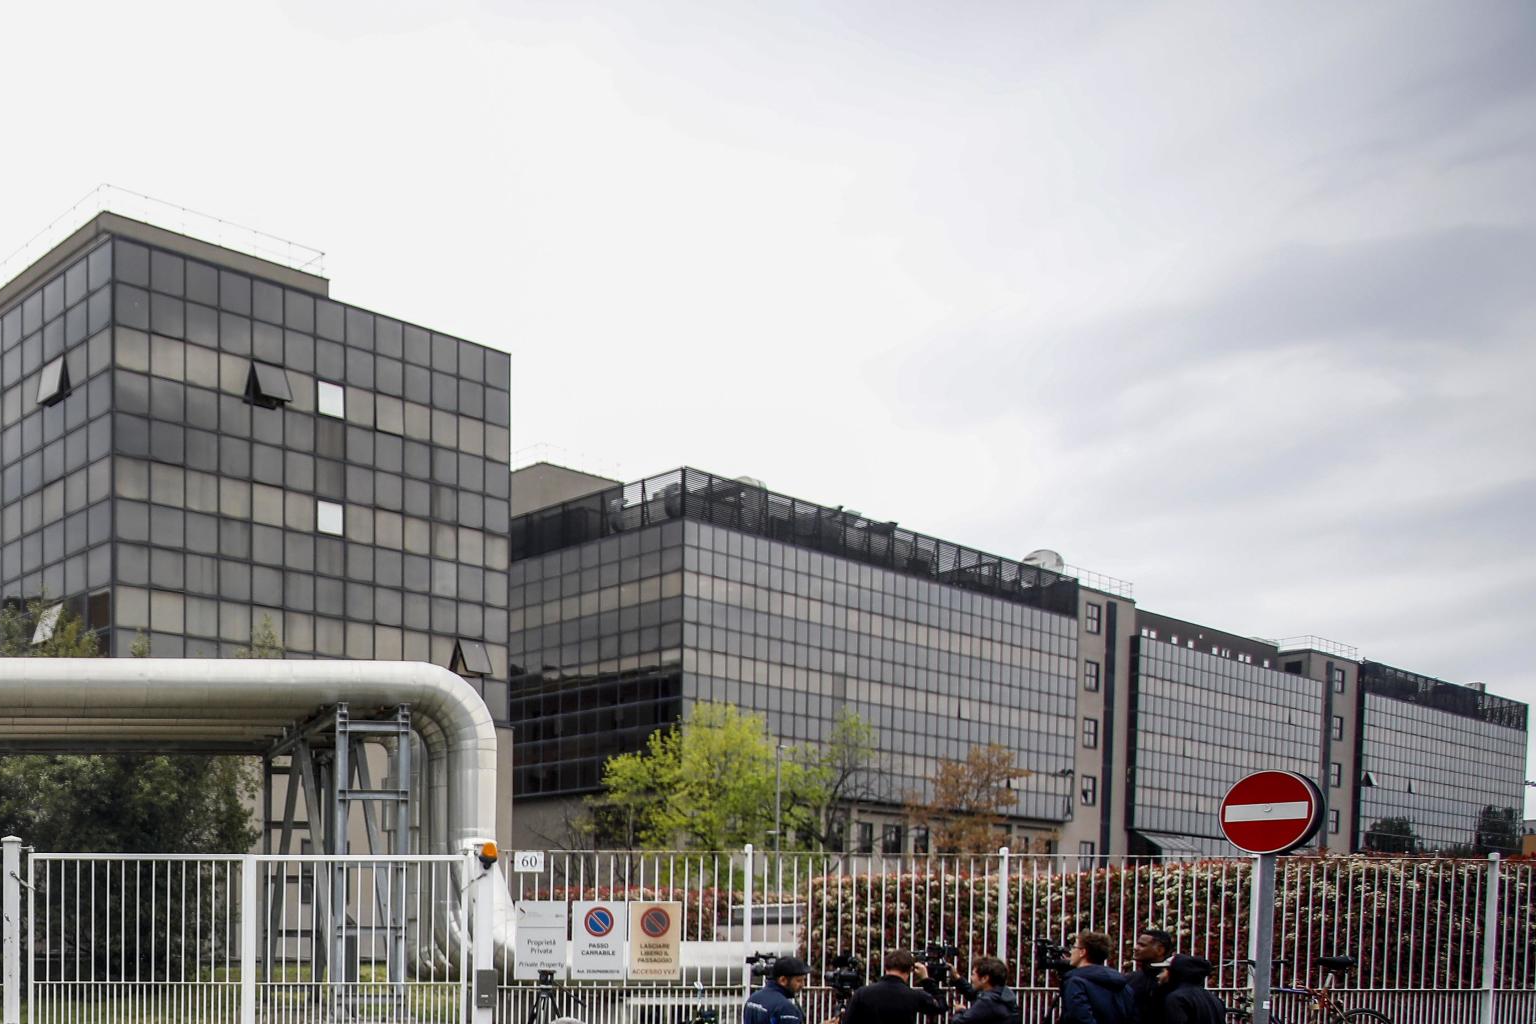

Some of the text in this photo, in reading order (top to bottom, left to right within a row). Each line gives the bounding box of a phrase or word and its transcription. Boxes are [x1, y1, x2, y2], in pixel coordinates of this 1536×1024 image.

[521, 855, 538, 868] 60
[527, 938, 556, 947] Proprietà
[539, 961, 564, 969] Property
